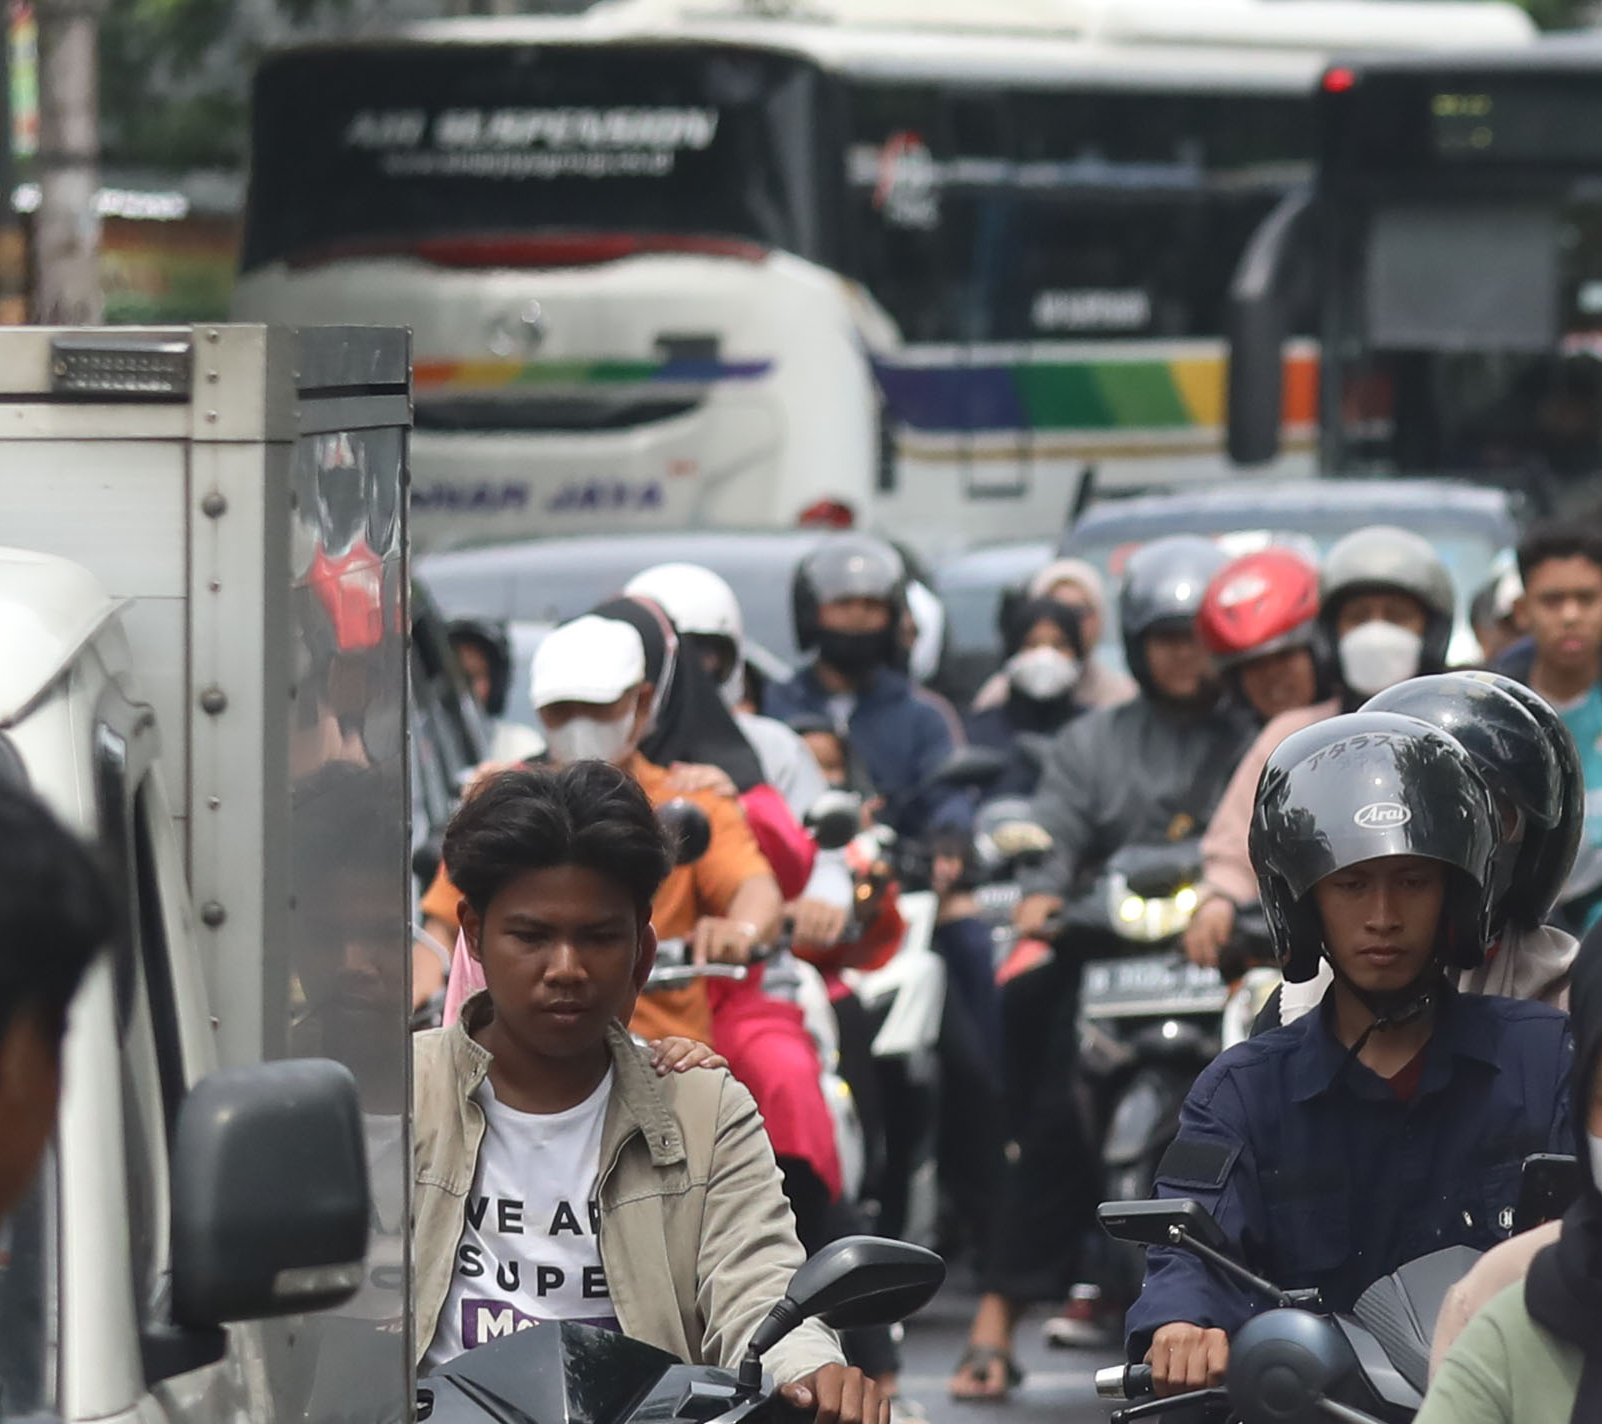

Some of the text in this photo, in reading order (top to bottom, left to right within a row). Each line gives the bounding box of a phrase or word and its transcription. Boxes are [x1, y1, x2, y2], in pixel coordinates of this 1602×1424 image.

[433, 107, 720, 149] SUSPENSION
[543, 477, 665, 511] JAYA
[1363, 804, 1406, 824] Arai
